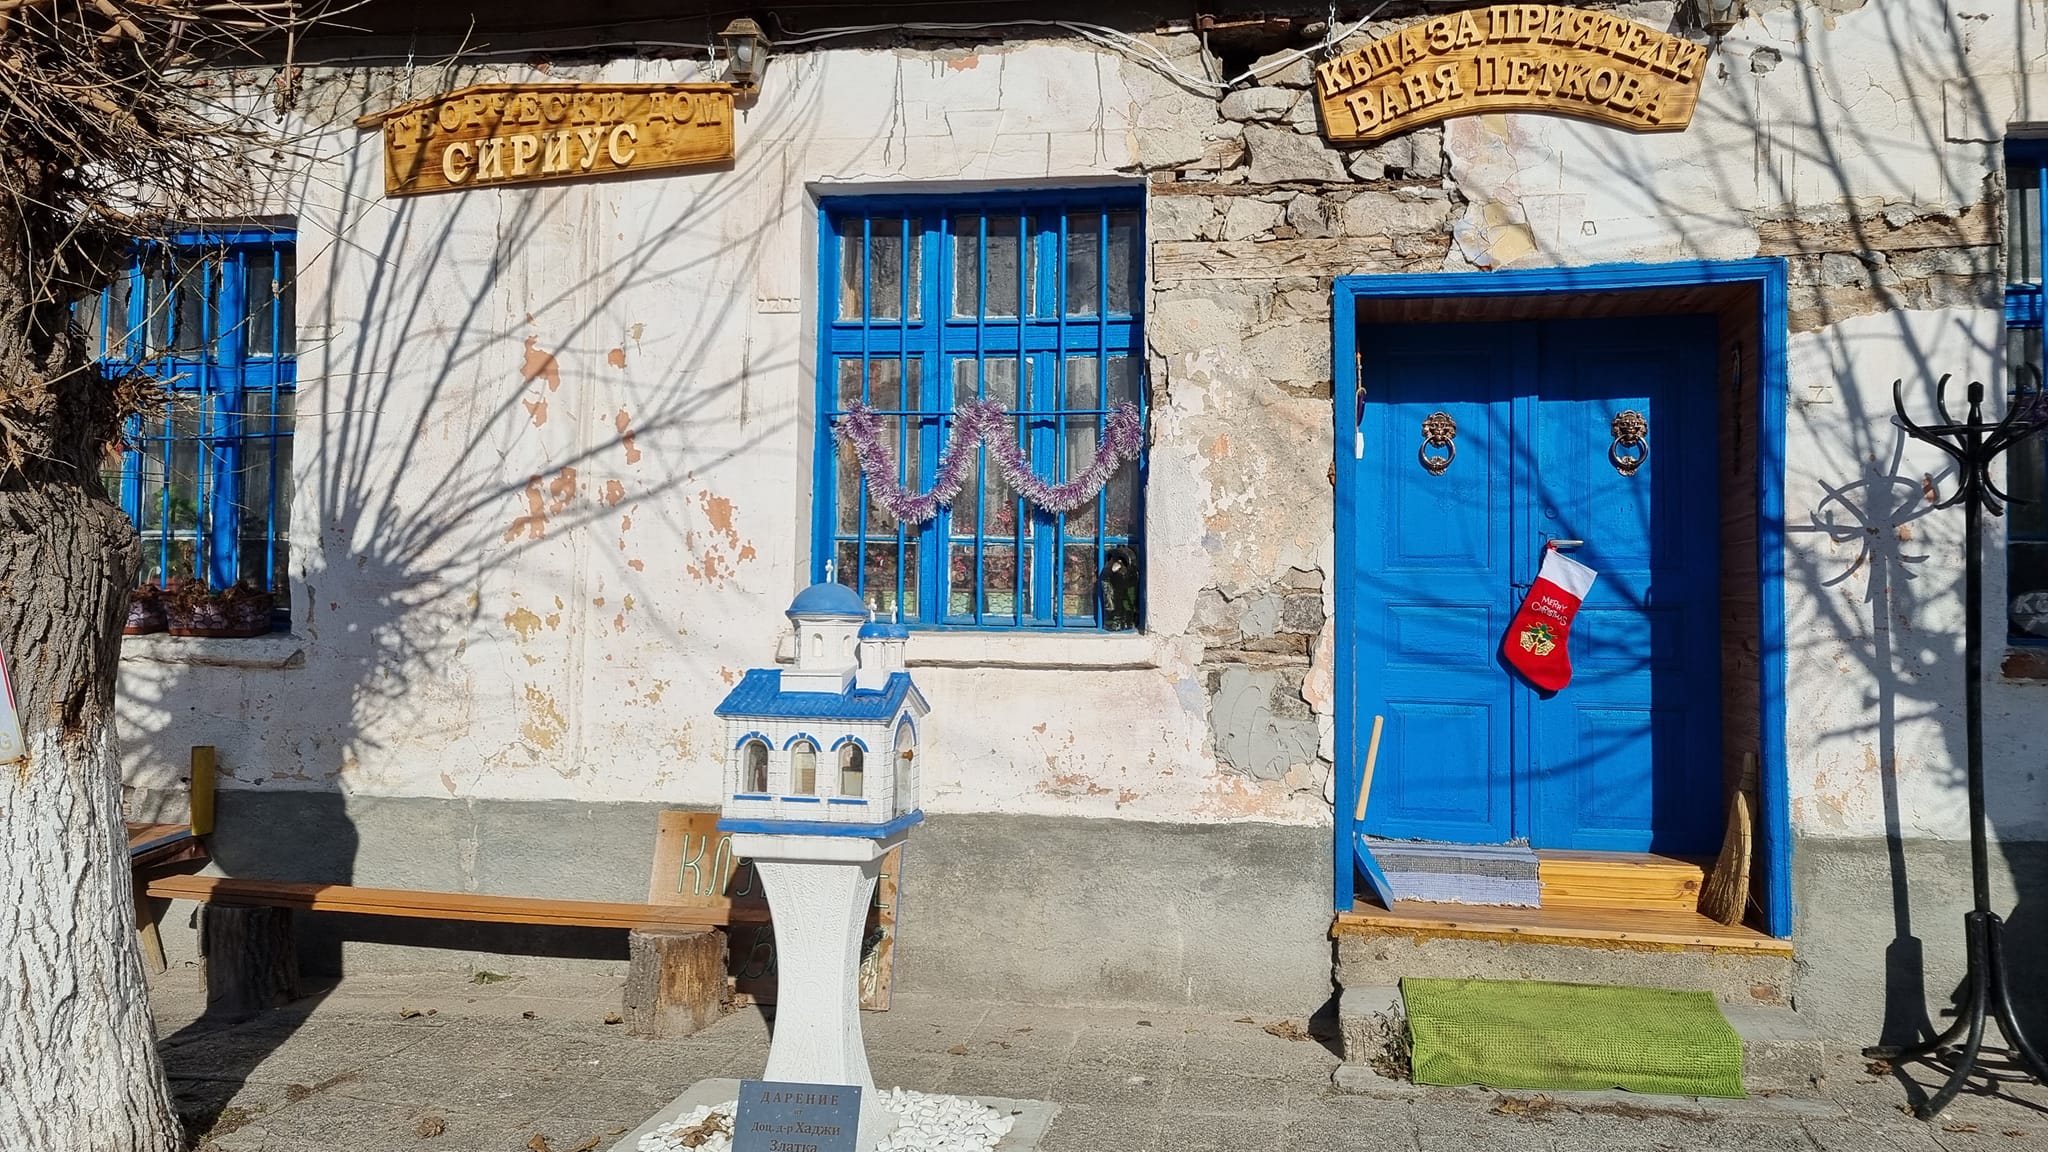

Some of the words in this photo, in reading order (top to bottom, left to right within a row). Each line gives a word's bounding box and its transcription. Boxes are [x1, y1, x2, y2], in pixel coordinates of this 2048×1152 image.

[1317, 34, 1427, 98] КЪЩА
[1425, 9, 1483, 55] ЗА
[1489, 4, 1707, 83] ПРИЯТЕЛИ
[389, 91, 627, 149] ТВОРЧЕСКИ
[646, 91, 723, 127] ДОМ
[1346, 61, 1465, 133] ВАНЯ
[1473, 56, 1671, 124] ПЕТКОВА
[442, 123, 638, 183] СИРИУС
[677, 833, 767, 898] КЛУ
[760, 1091, 839, 1106] ДАРЕНИЕ
[752, 1121, 775, 1133] Доц.
[777, 1125, 793, 1135] д-р
[796, 1121, 840, 1136] Хаджи
[770, 1139, 818, 1152] Златка
